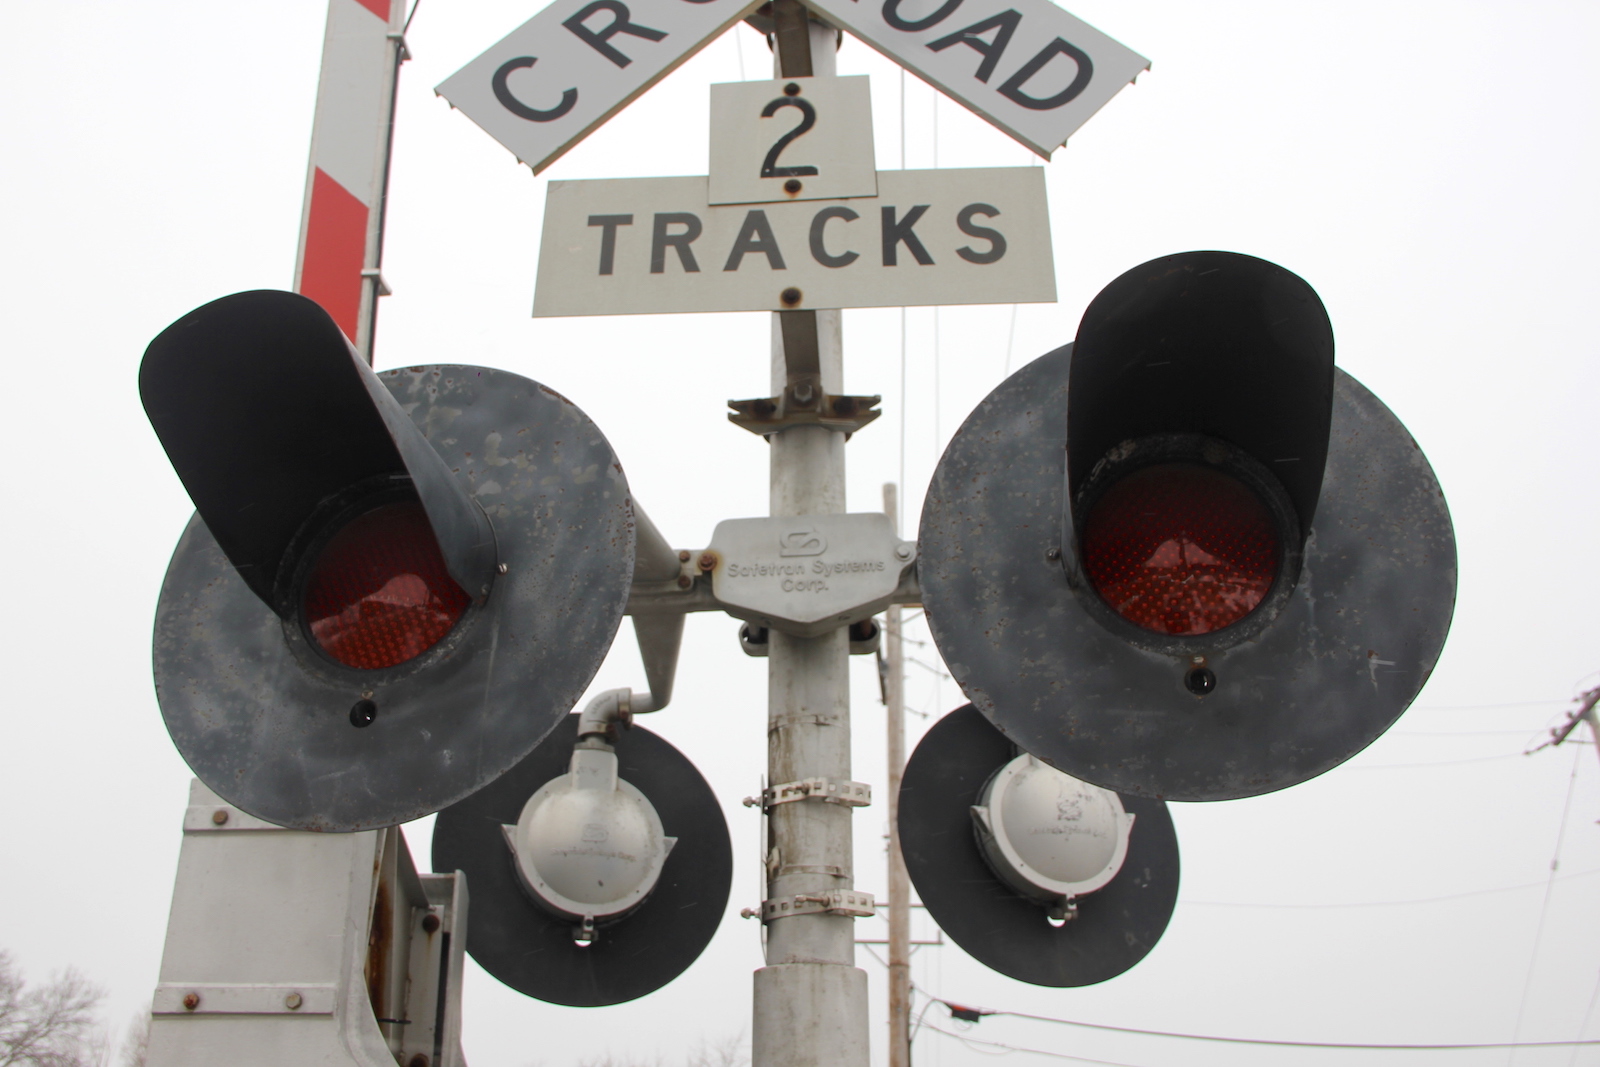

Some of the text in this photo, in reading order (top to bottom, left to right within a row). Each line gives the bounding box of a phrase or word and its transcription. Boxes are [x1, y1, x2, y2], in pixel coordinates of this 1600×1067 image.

[491, 0, 718, 123] CR
[850, 0, 1094, 111] OAD
[760, 95, 819, 178] 2
[587, 202, 1008, 276] TRACKS
[727, 560, 886, 577] Safetran Systems
[781, 579, 830, 593] Corp.
